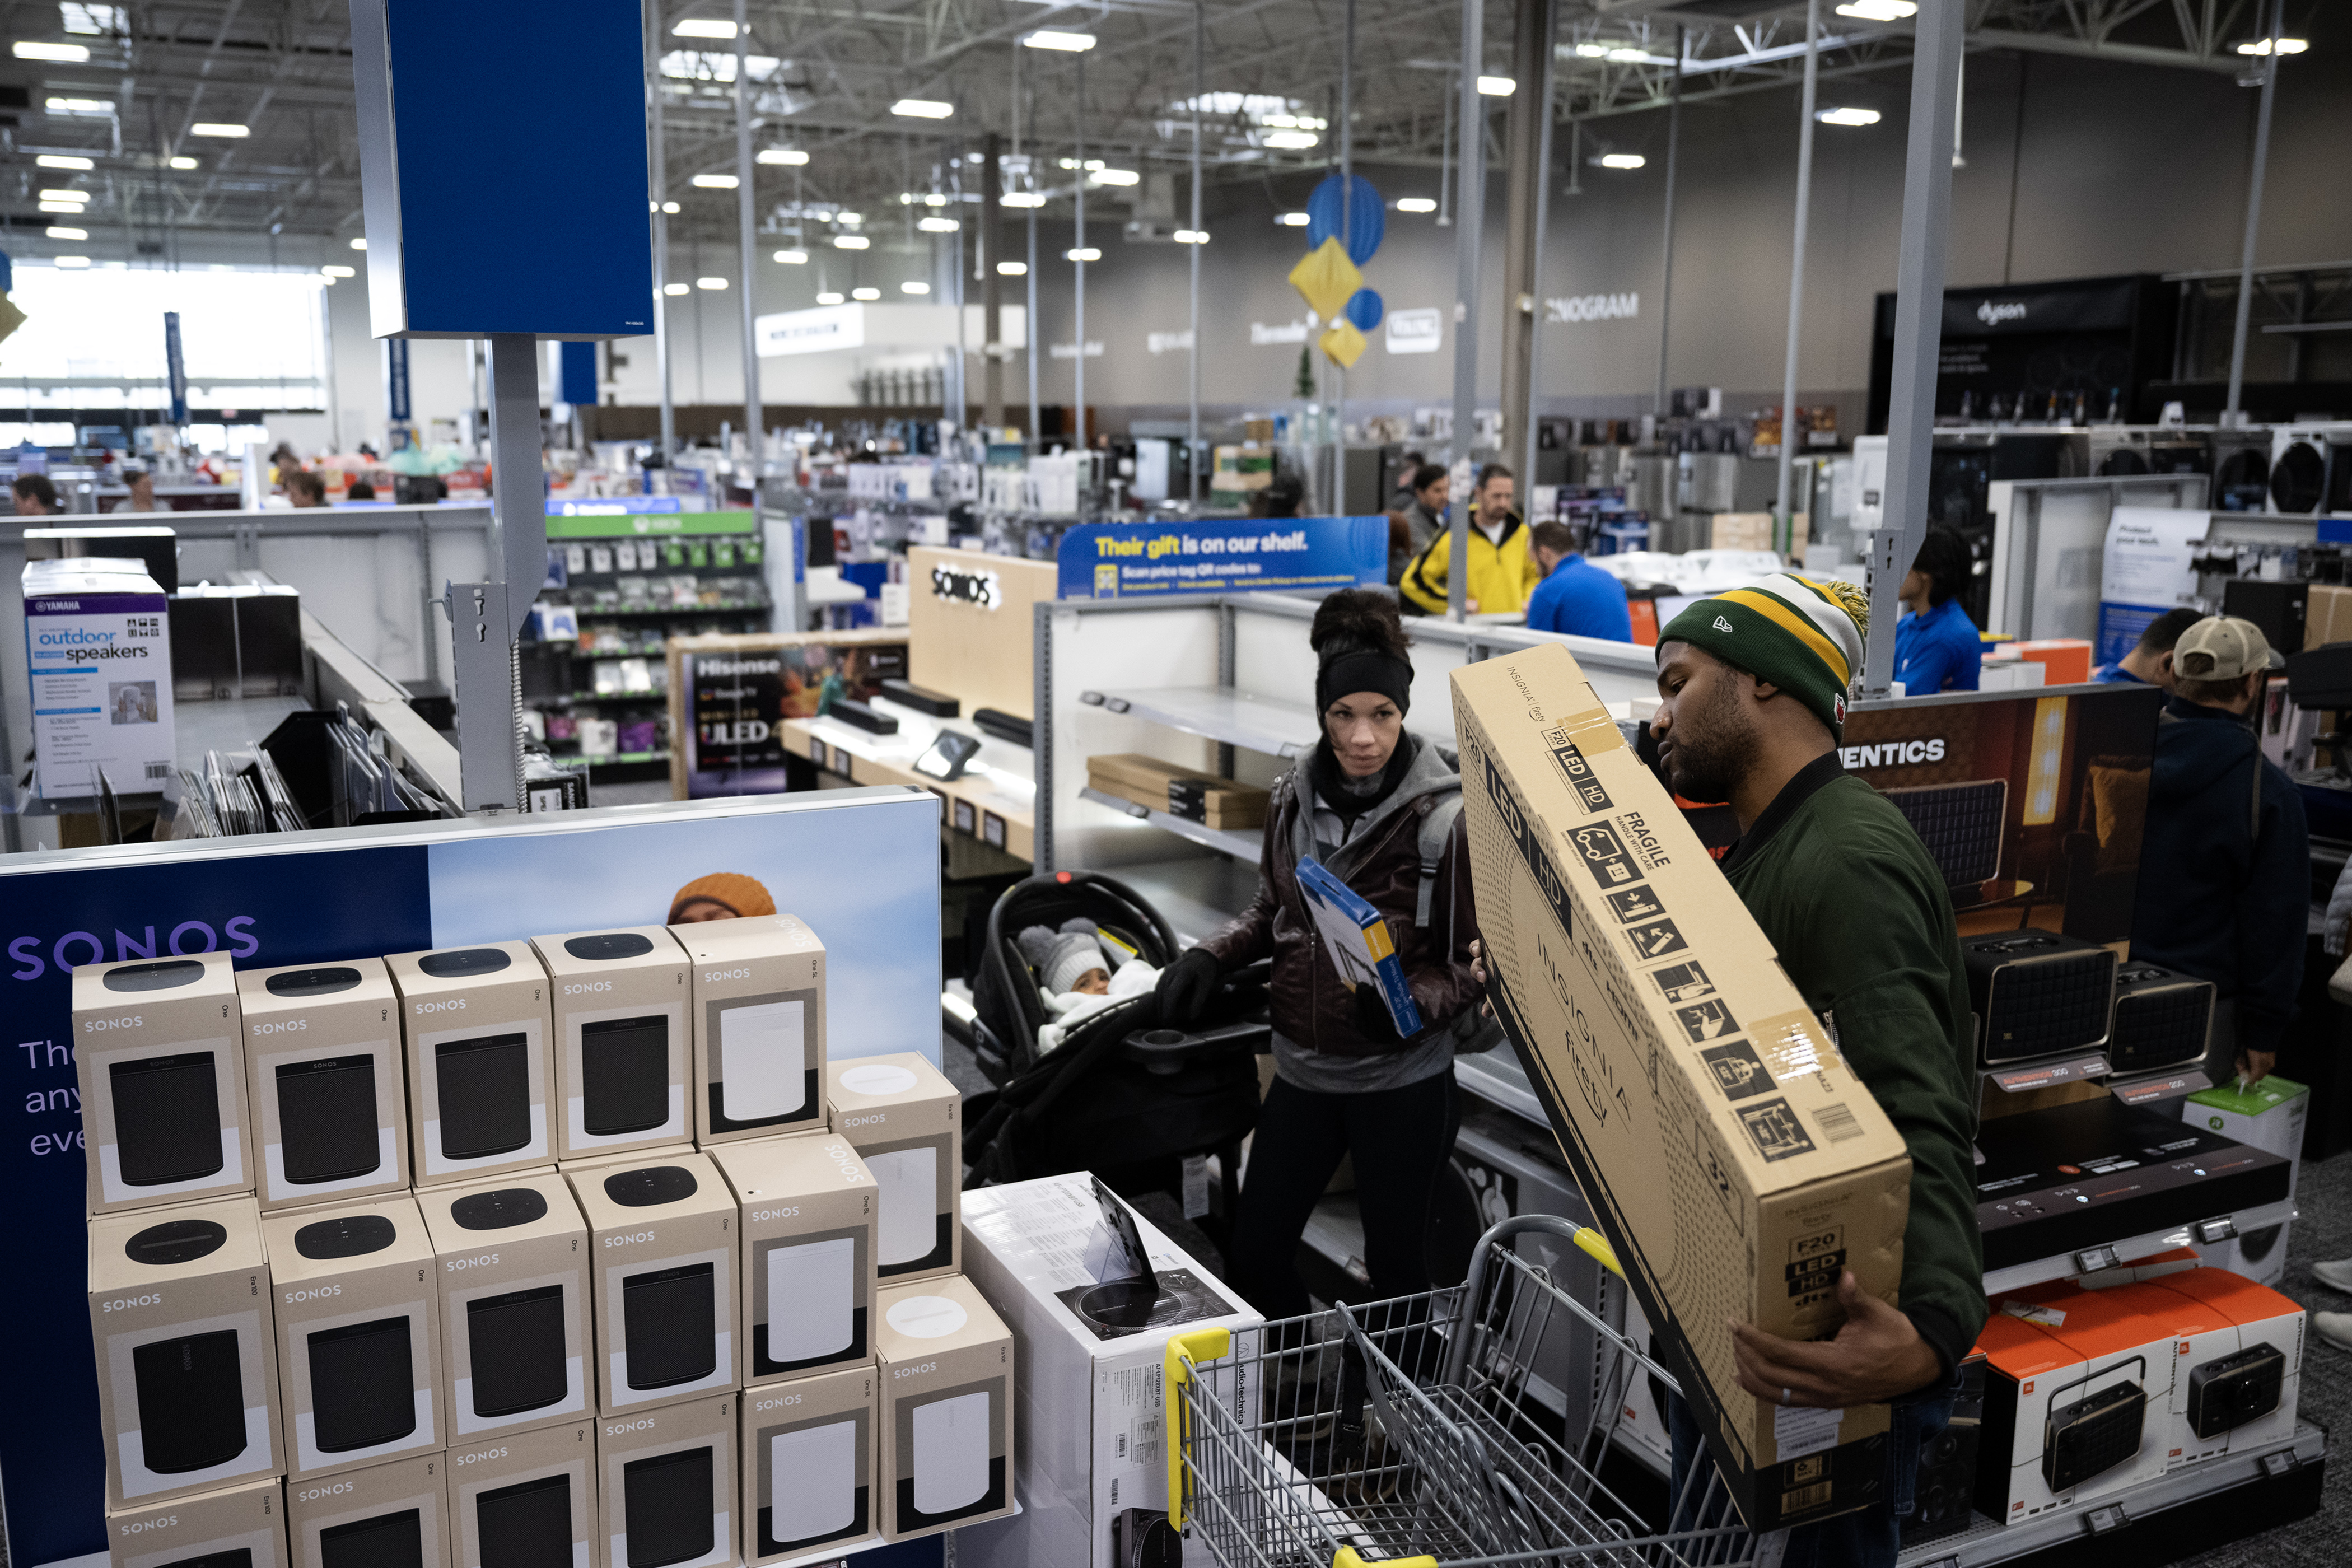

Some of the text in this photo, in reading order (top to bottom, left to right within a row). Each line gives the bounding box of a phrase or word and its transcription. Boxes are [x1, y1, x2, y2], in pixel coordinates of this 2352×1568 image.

[1977, 299, 2027, 326] dyson
[1095, 530, 1309, 559] Their gift is on our shelf.
[46, 601, 80, 611] YAMAHA
[39, 628, 116, 645] outdoor
[66, 643, 148, 664] speakers
[699, 659, 781, 677] Hisense
[1506, 666, 1533, 702] INSIGNIA
[1466, 725, 1481, 764] F20
[1551, 731, 1566, 745] F20
[1559, 750, 1586, 775] LED
[1584, 785, 1605, 803] HD
[1491, 769, 1522, 839] LED
[1614, 815, 1654, 871] HANDLE WITH CARE
[1623, 811, 1671, 867] FRAGILE
[1539, 852, 1561, 905] HD
[774, 918, 814, 949] SONOS
[8, 916, 259, 981] SONOS
[704, 968, 751, 982] SONOS
[564, 981, 612, 995] SONOS
[416, 999, 467, 1014] SONOS
[85, 1016, 143, 1032] SONOS
[253, 1020, 307, 1036] SONOS
[1537, 933, 1631, 1122] INSIGNIA
[19, 1040, 77, 1069] Th
[150, 1059, 175, 1067] SONOS
[844, 1113, 886, 1127] SONOS
[825, 1144, 865, 1183] SONOS
[1707, 1151, 1730, 1193] 32
[752, 1206, 800, 1222] SONOS
[605, 1231, 655, 1248] SONOS
[1798, 1233, 1835, 1252] F20
[447, 1253, 500, 1272] SONOS
[1795, 1255, 1837, 1276] LED
[658, 1271, 680, 1279] SONOS
[1801, 1273, 1828, 1289] HD
[102, 1293, 162, 1313] SONOS
[286, 1285, 342, 1304] SONOS
[894, 1362, 937, 1379] SONOS
[756, 1394, 802, 1411] SONOS
[606, 1418, 655, 1436] SONOS
[457, 1446, 508, 1466] SONOS
[299, 1481, 353, 1502] SONOS
[121, 1515, 178, 1536] SONOS
